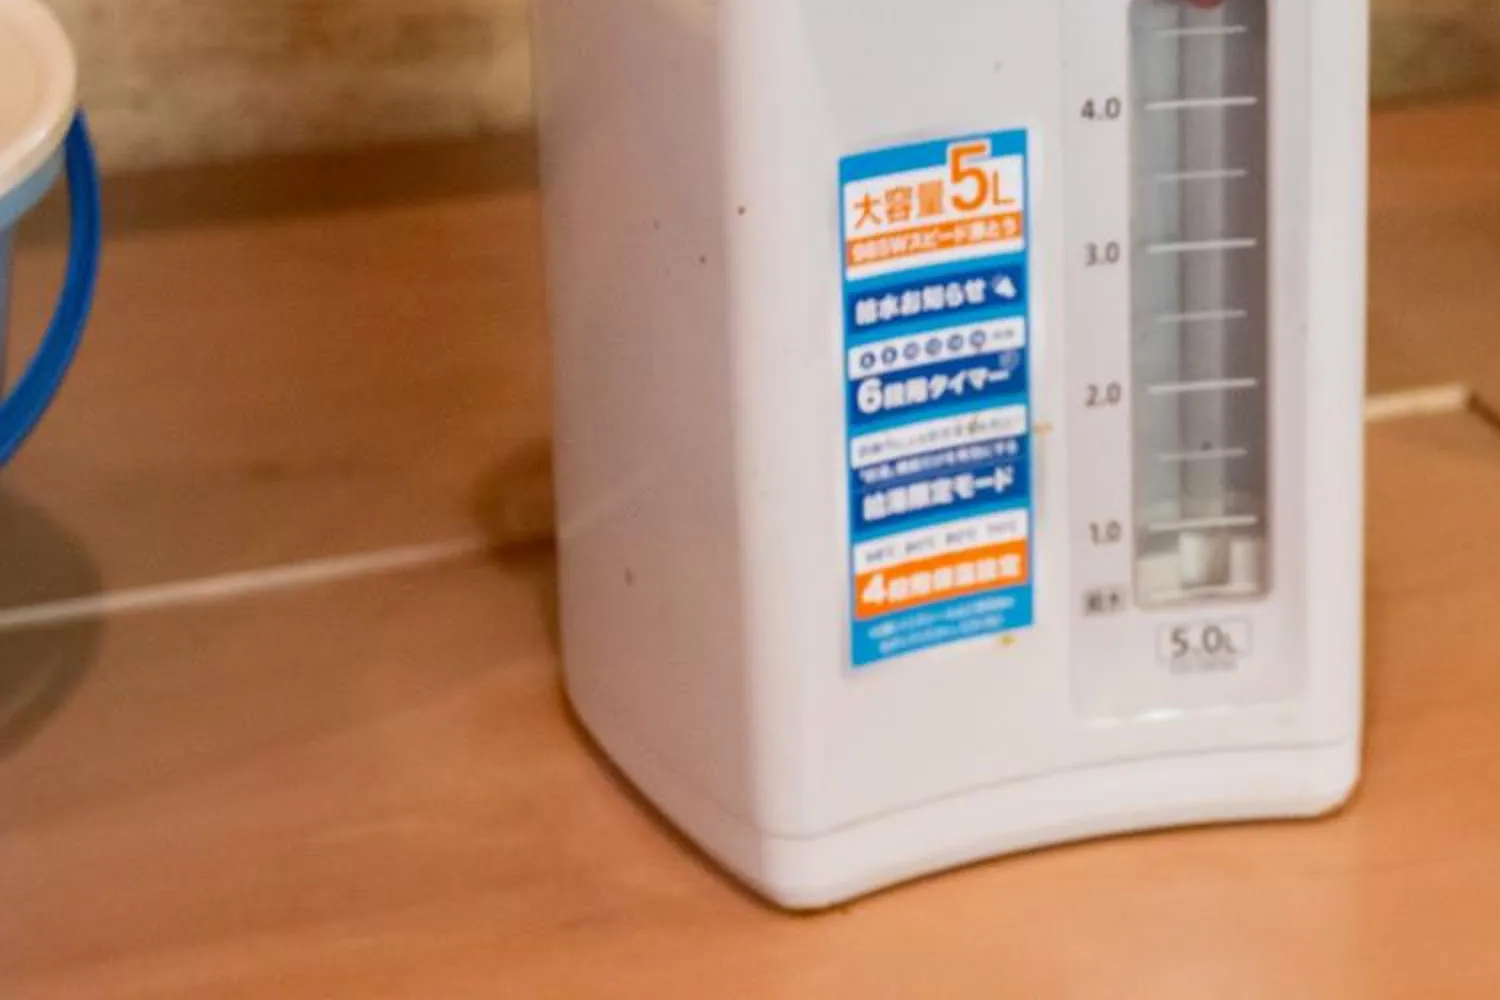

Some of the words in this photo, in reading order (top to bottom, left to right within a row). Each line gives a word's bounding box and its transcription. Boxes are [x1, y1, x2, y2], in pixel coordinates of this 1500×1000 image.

[1081, 97, 1121, 120] 4.0
[1084, 241, 1120, 266] 3.0
[1086, 382, 1121, 407] 2.0
[1089, 520, 1121, 546] 1.0
